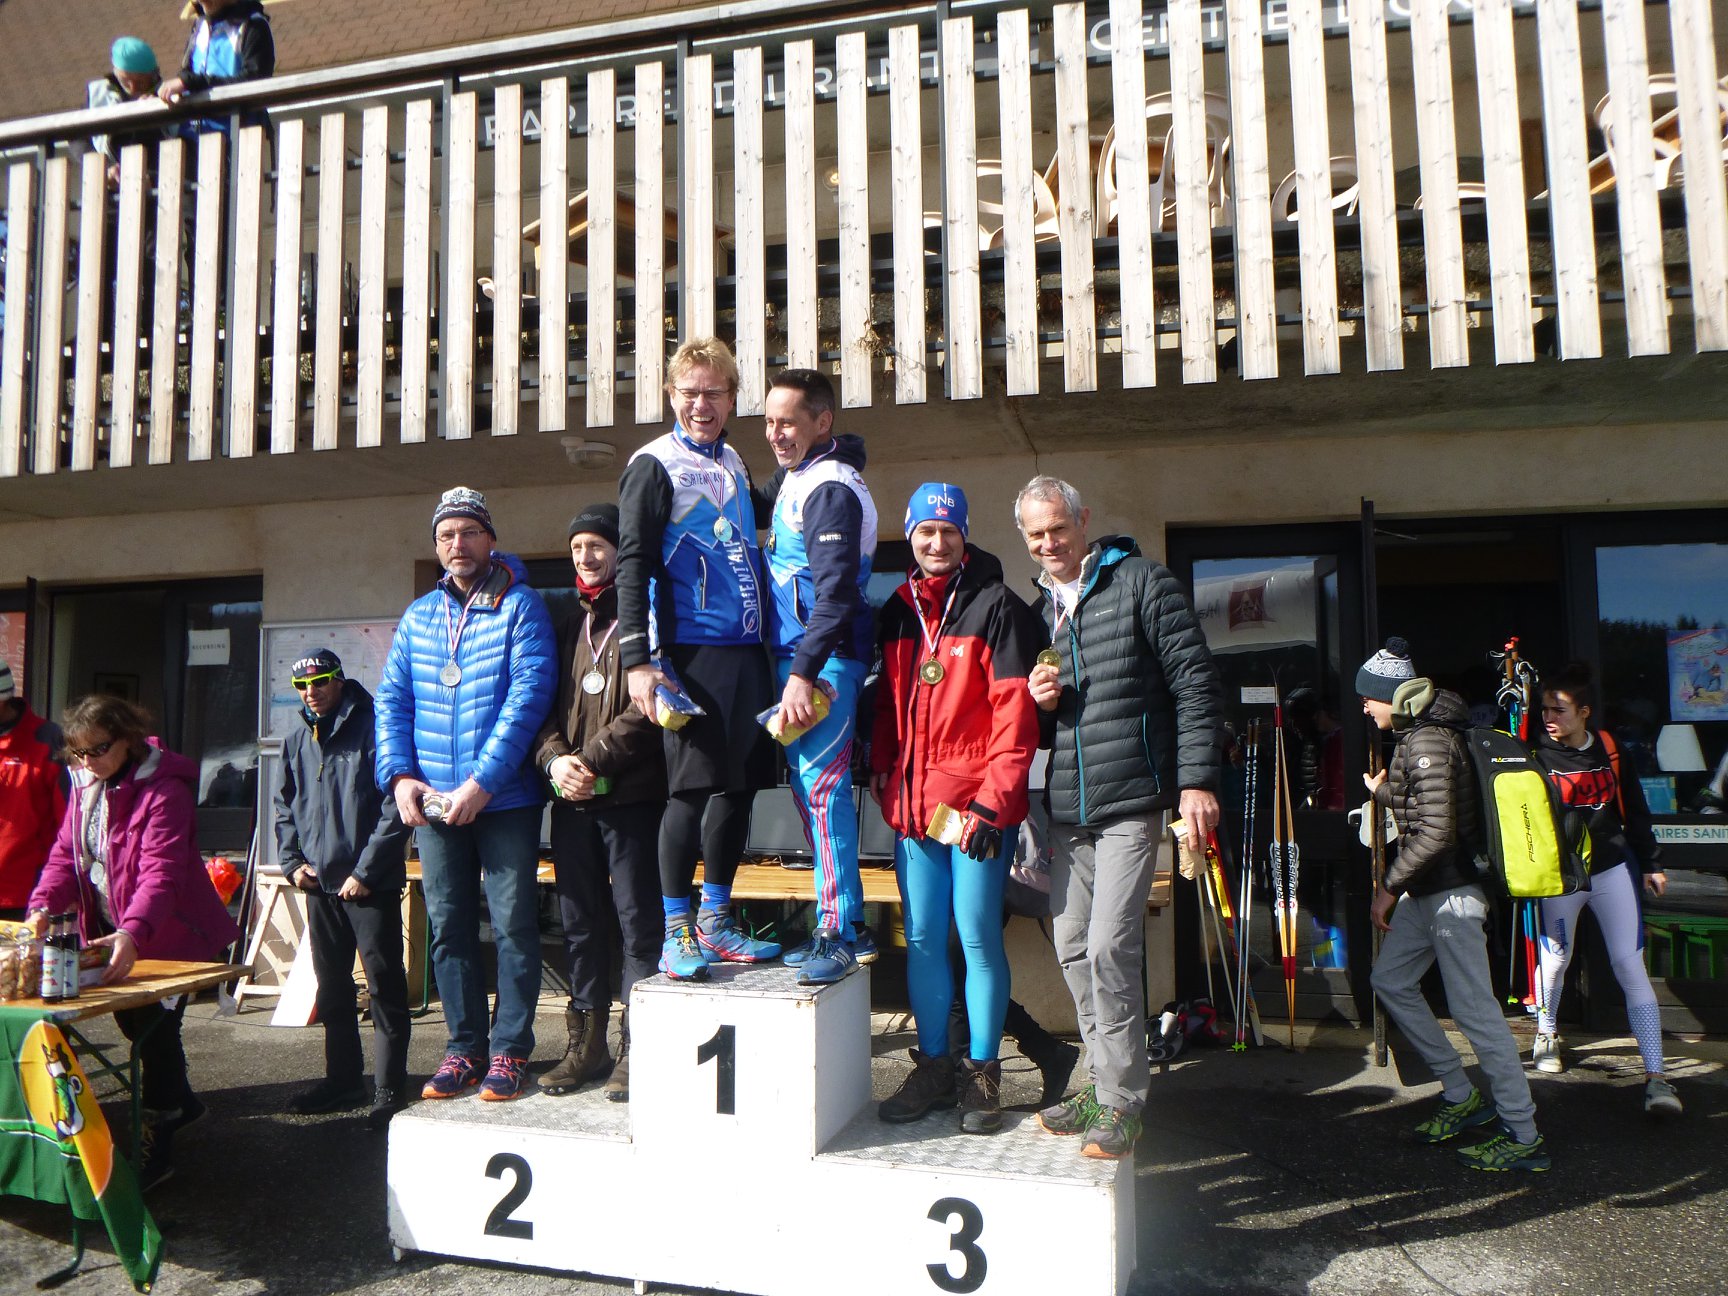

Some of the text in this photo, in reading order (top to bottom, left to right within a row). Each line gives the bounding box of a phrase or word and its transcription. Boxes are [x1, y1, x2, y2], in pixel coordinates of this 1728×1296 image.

[1089, 1, 1288, 51] CETE
[927, 492, 955, 508] DNB
[1523, 808, 1536, 863] FISCHER
[697, 1025, 737, 1115] 1
[484, 1153, 533, 1240] 2
[926, 1197, 988, 1294] 3
